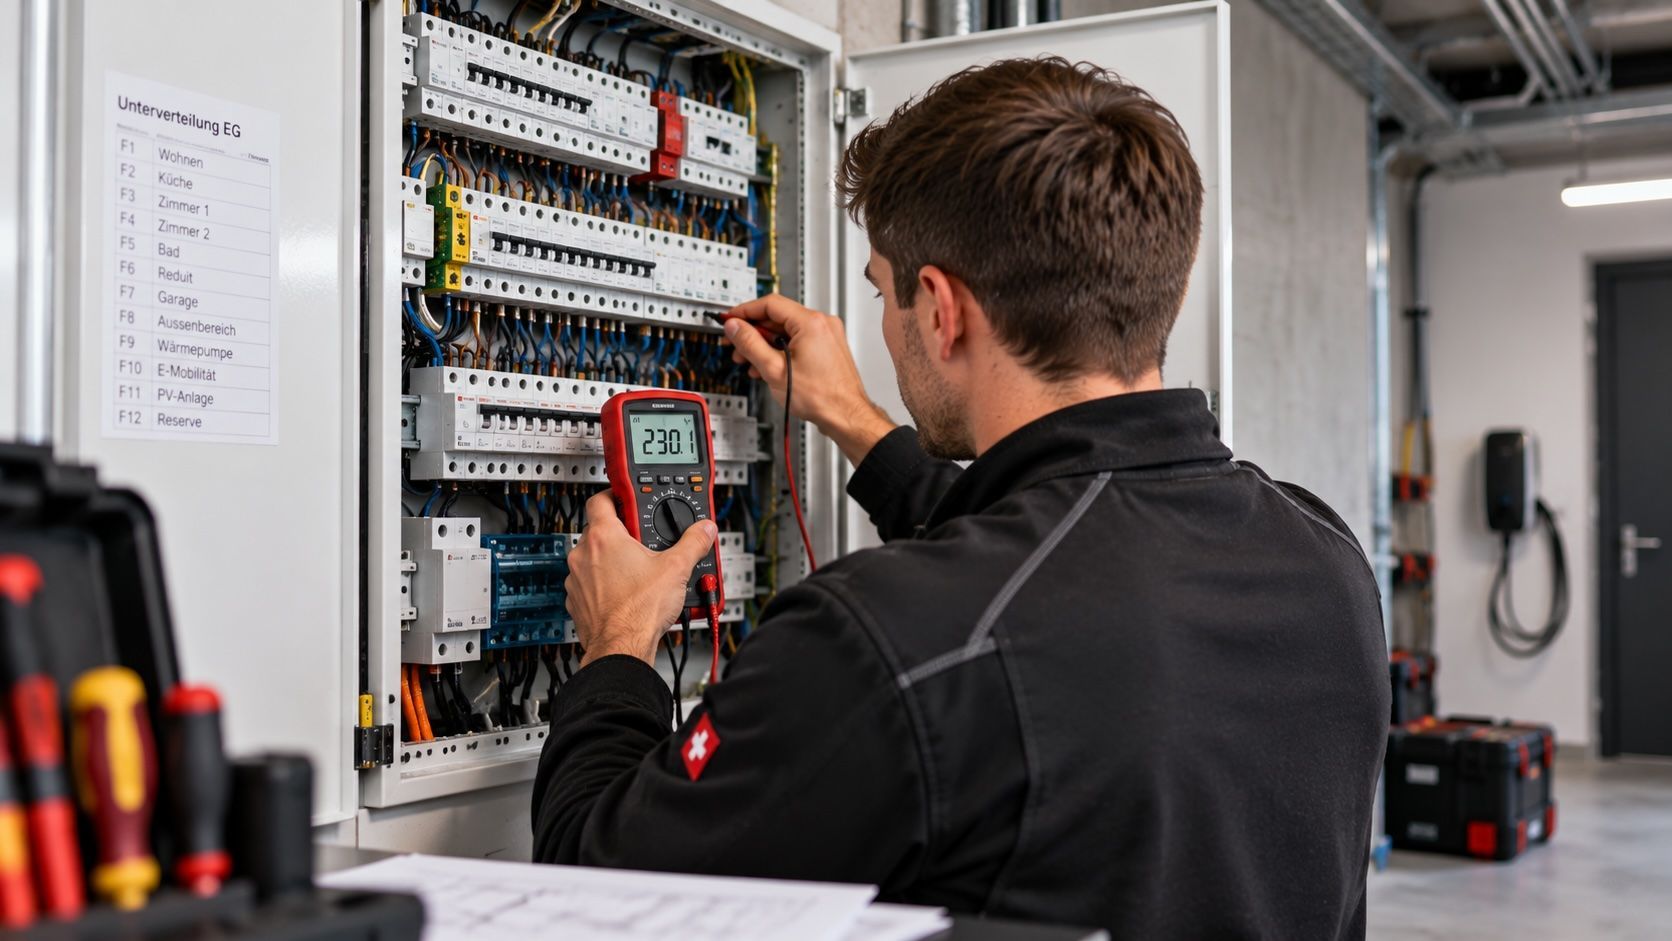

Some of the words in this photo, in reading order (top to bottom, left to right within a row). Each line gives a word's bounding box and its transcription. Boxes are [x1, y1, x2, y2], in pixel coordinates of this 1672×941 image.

[118, 95, 219, 136] Unterverteilung
[224, 122, 241, 138] EG
[121, 138, 134, 153] F1
[158, 148, 203, 168] Wohnen
[120, 163, 135, 178] F2
[158, 171, 193, 189] Küche
[120, 187, 135, 202] F3
[158, 195, 200, 214] Zimmer
[204, 205, 209, 216] 1
[120, 212, 135, 226] F4
[158, 219, 200, 238] Zimmer
[204, 228, 210, 240] 2
[120, 235, 135, 250] F5
[158, 242, 180, 258] Bad
[120, 260, 135, 275] F6
[158, 267, 193, 284] Reduit
[120, 285, 135, 299] F7
[158, 290, 198, 310] Garage
[120, 310, 134, 324] F8
[158, 315, 236, 336] Aussenbereich
[120, 335, 135, 349] F9
[158, 339, 233, 361] Wärmepumpe
[120, 360, 142, 375] F10
[158, 364, 216, 382] E-Mobilität
[119, 385, 141, 399] F11
[158, 388, 214, 407] PV-Anlage
[119, 410, 141, 424] F12
[158, 413, 202, 428] Reserve
[643, 429, 694, 454] 230.1
